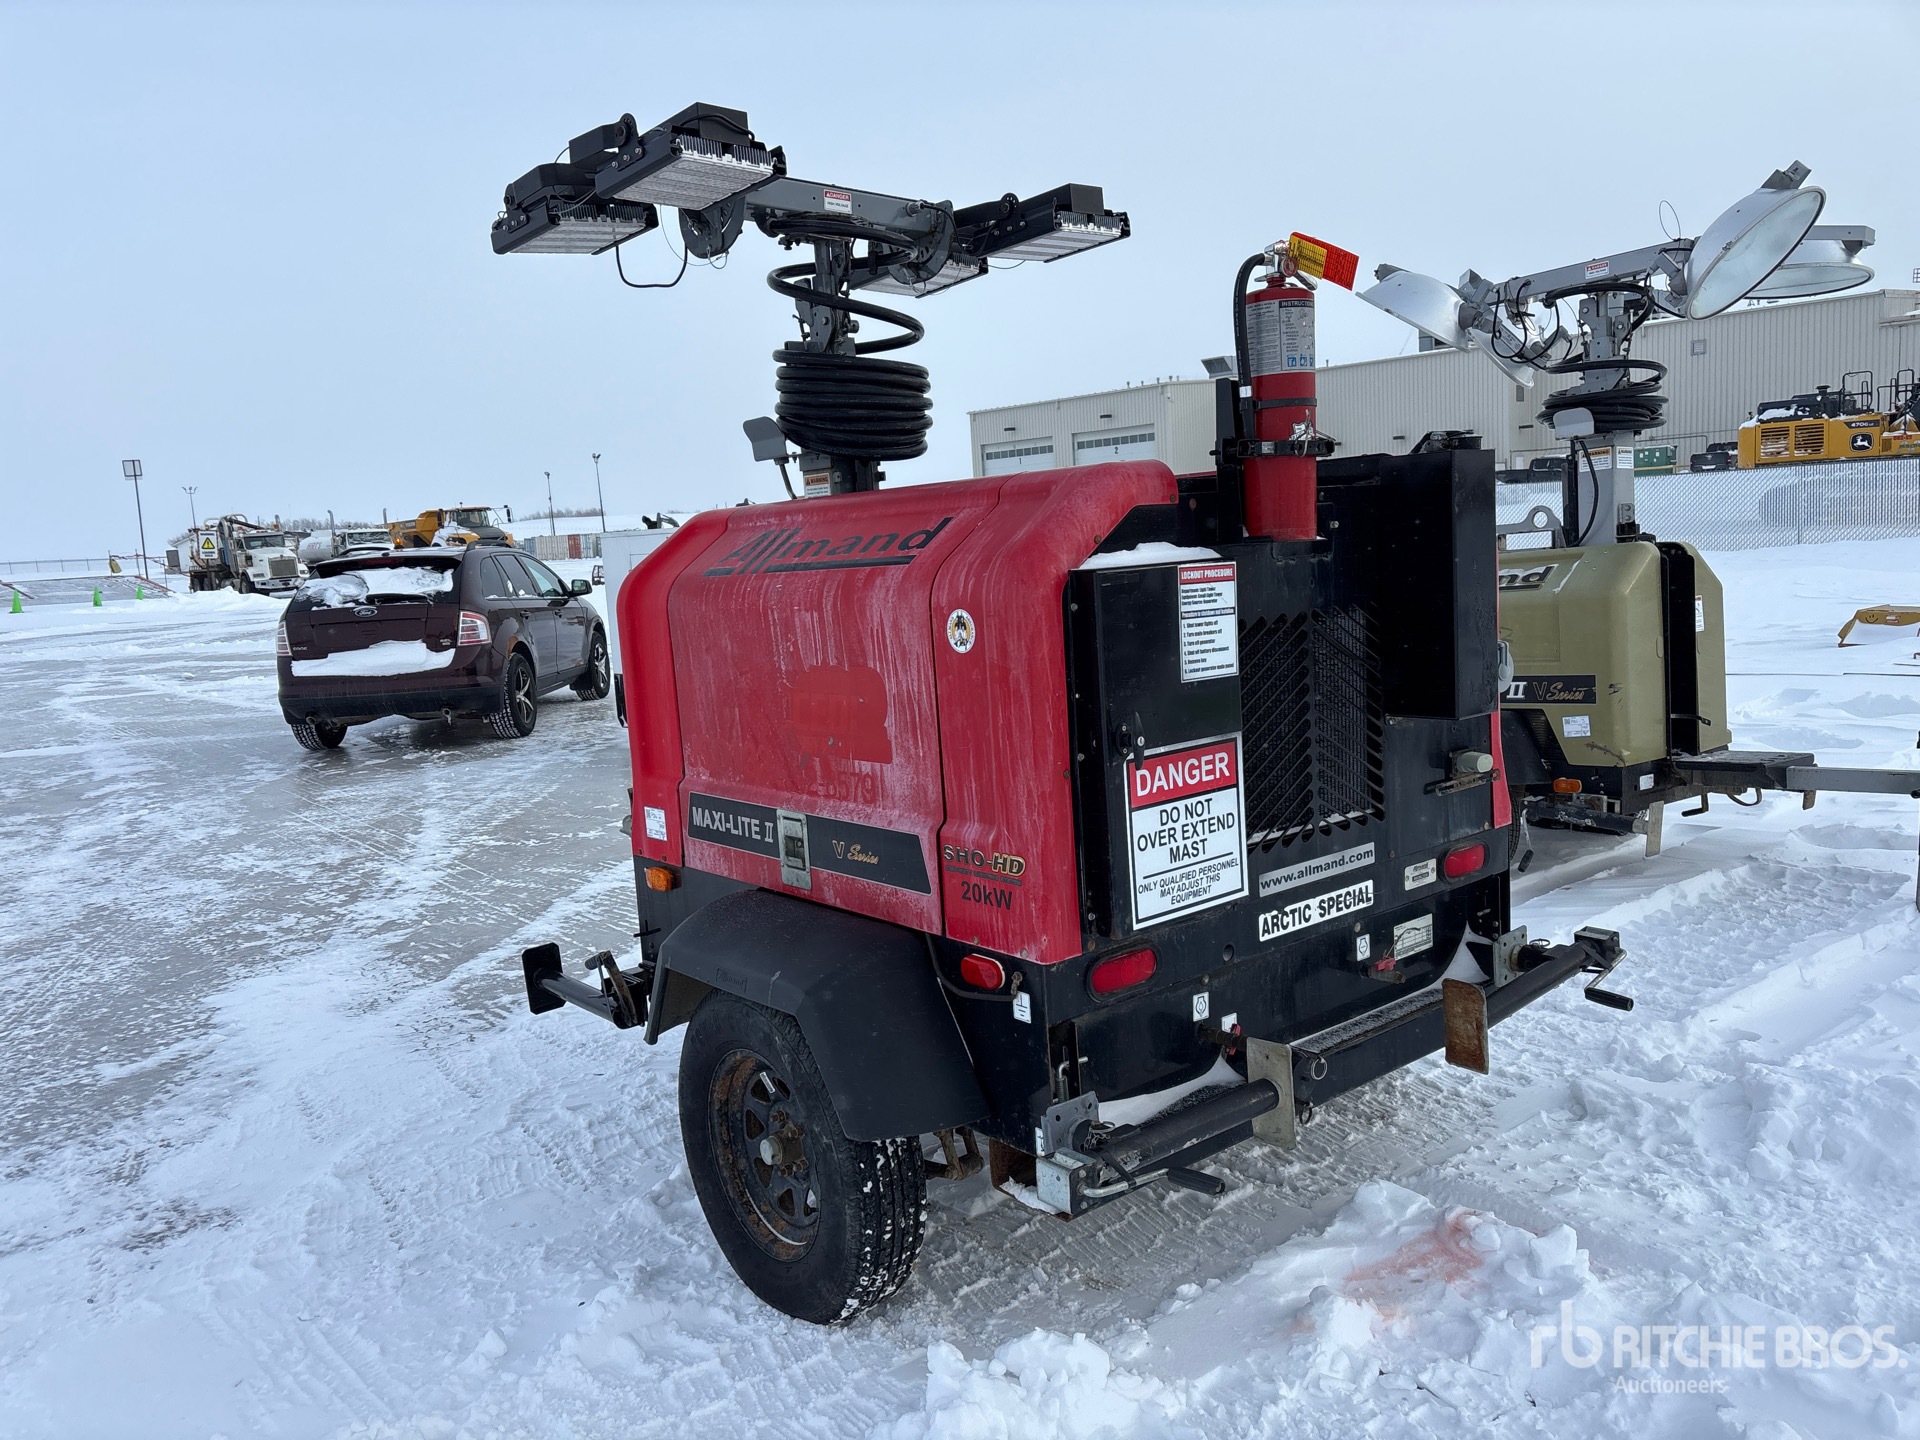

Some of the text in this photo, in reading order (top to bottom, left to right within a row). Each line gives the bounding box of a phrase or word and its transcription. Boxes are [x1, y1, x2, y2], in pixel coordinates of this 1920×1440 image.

[830, 192, 850, 200] DANGER
[704, 517, 954, 576] Allmand
[1181, 568, 1233, 580] LOCKOUT PROCEDURE
[1506, 682, 1585, 700] II V Series
[1136, 752, 1230, 797] DANGER
[692, 807, 761, 840] MAXI-LITE
[764, 822, 774, 843] II
[1160, 798, 1213, 826] DO NOT
[1137, 812, 1235, 852] OVER EXTEND
[832, 840, 879, 864] V Series
[944, 844, 1025, 877] SHO-HD
[1170, 838, 1208, 864] MAST
[1138, 858, 1239, 894] ONLY QUALIFIED PERSONNEL
[1260, 849, 1373, 890] www.allmand.com
[961, 880, 1012, 910] 20kW
[1160, 872, 1221, 898] MAY ADJUST THIS
[1171, 885, 1212, 905] EQUIPMENT
[1261, 884, 1372, 937] ARCTIC SPECIAL
